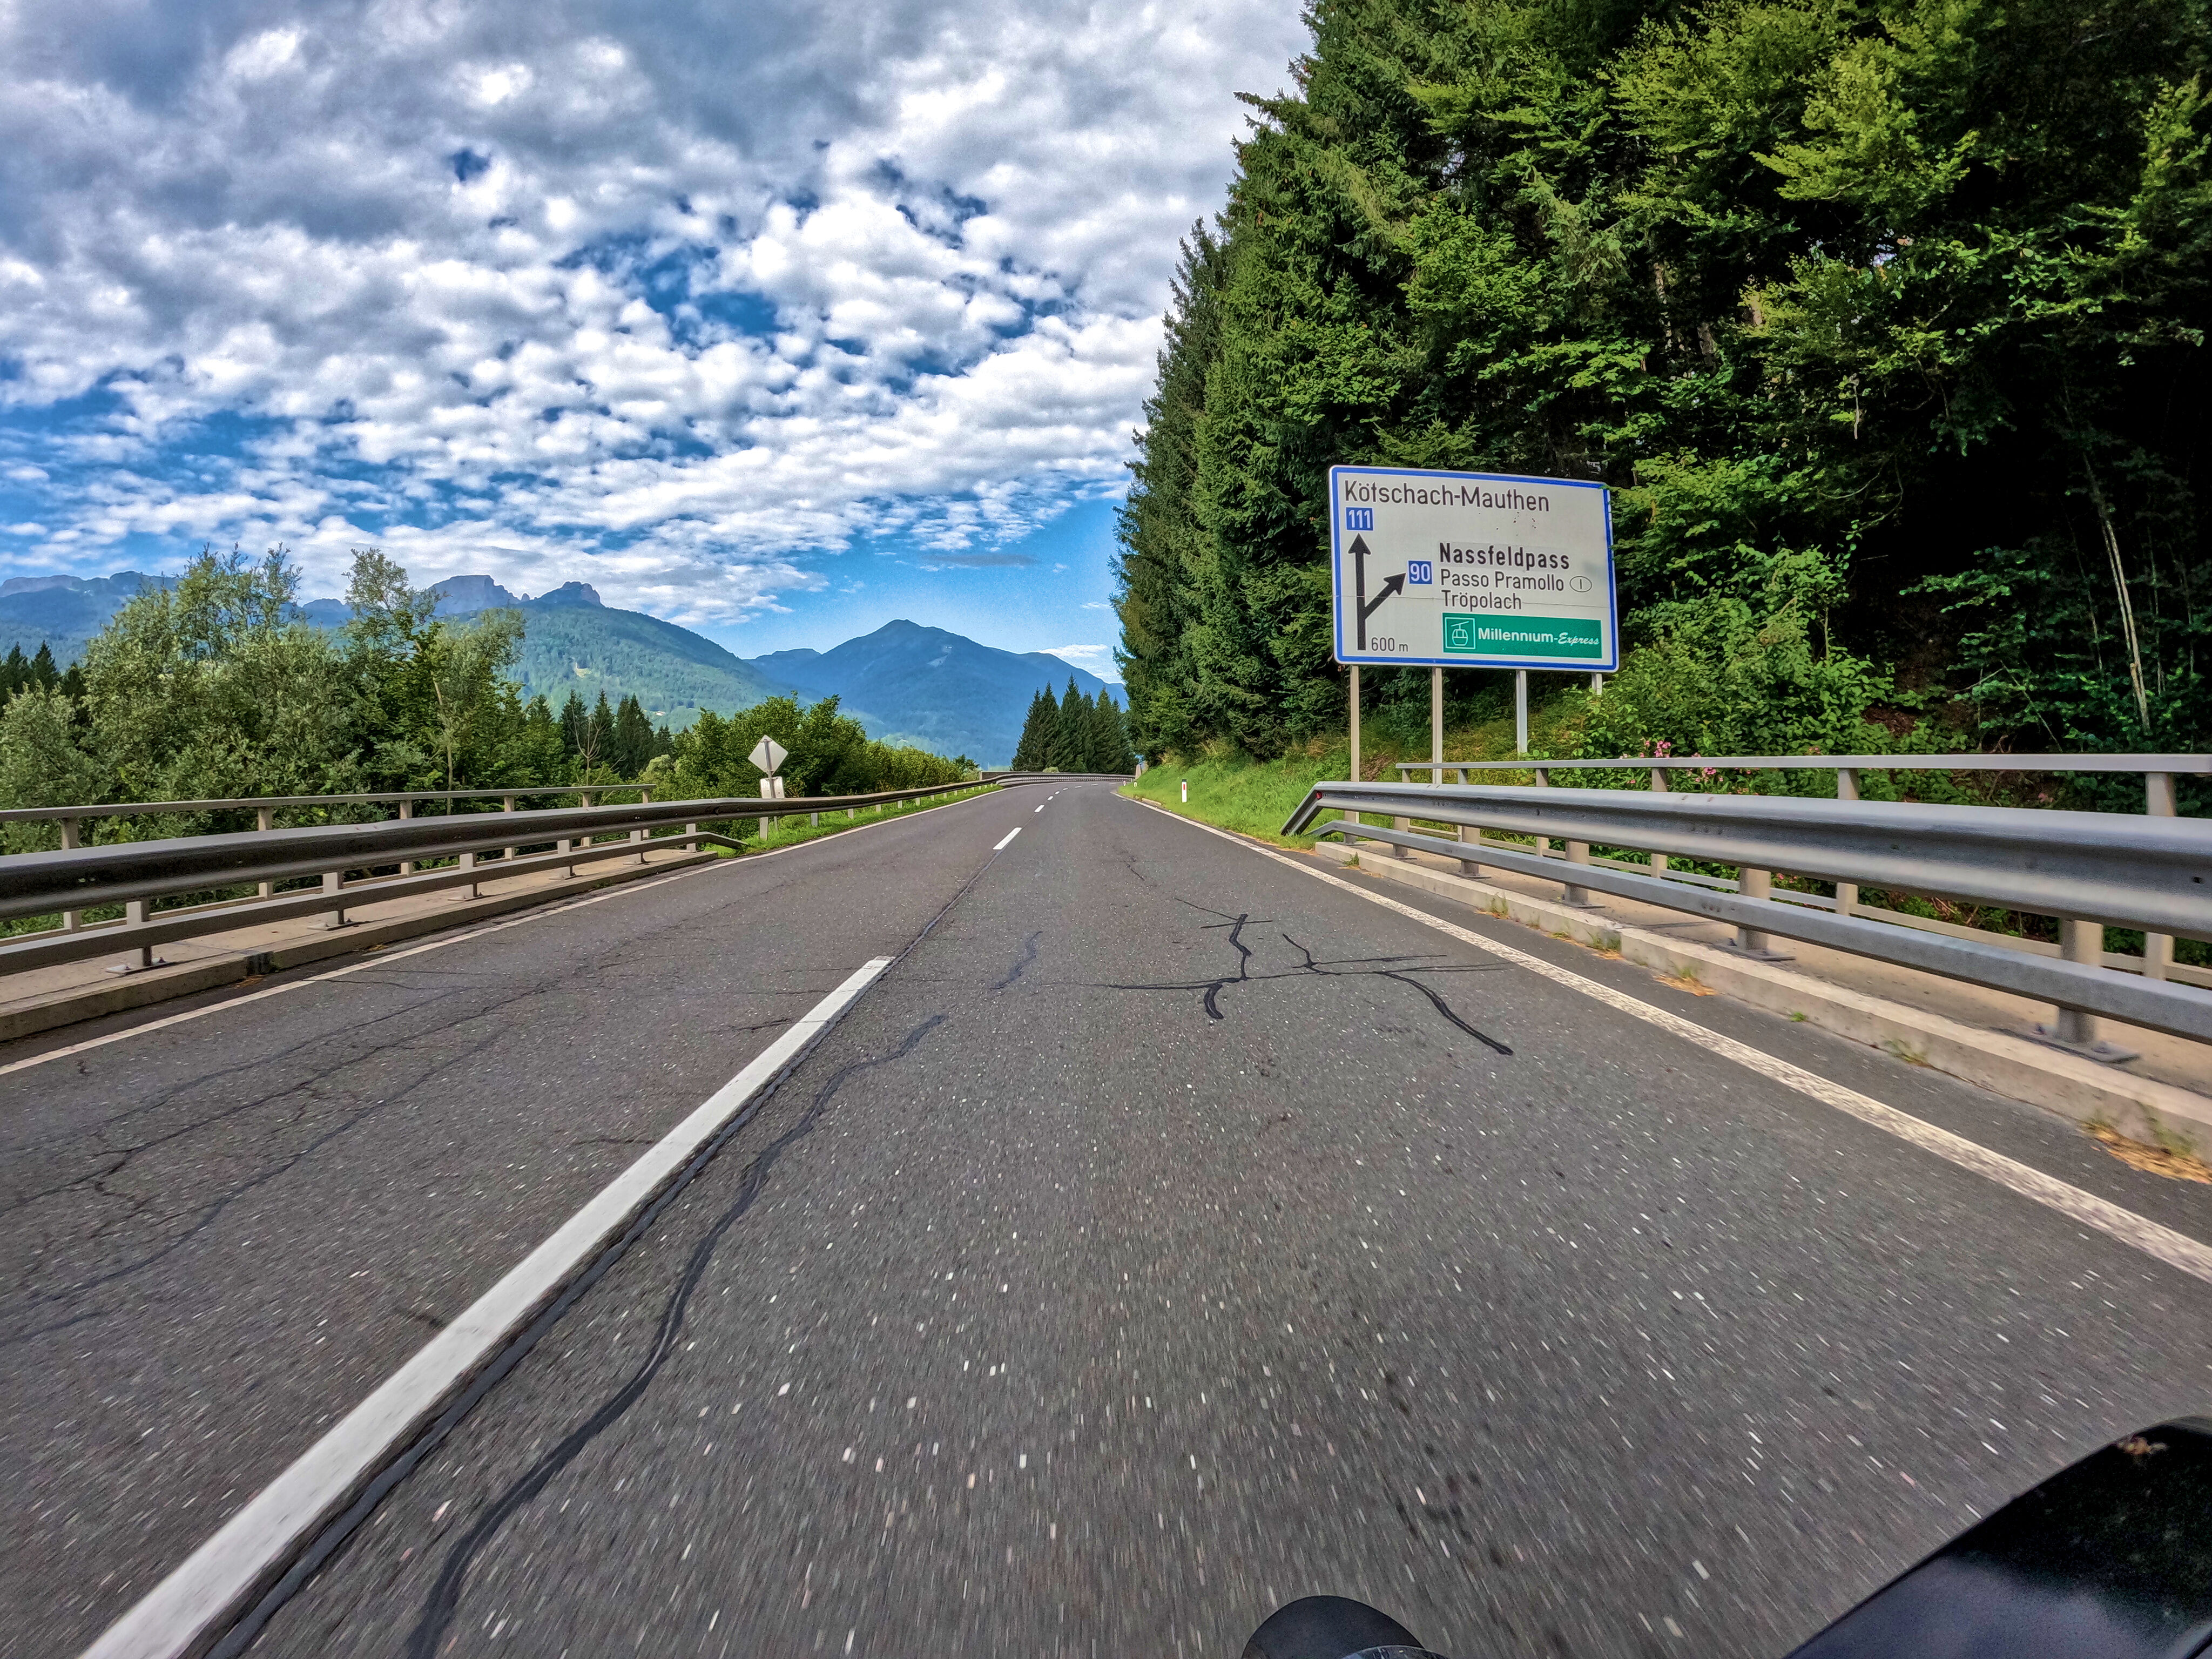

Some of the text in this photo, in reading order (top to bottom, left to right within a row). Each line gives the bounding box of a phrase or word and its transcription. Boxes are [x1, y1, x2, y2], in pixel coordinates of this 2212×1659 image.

[1345, 480, 1549, 512] Kötschach-Mauthen
[1349, 509, 1371, 529] 111
[1439, 542, 1570, 571] Nassfeldpass
[1410, 563, 1431, 583] 90
[1440, 569, 1564, 591] Passo Pramollo
[1441, 589, 1522, 612] Tröpolach
[1371, 637, 1408, 652] 600 m
[1478, 628, 1600, 646] Millennium-Express
